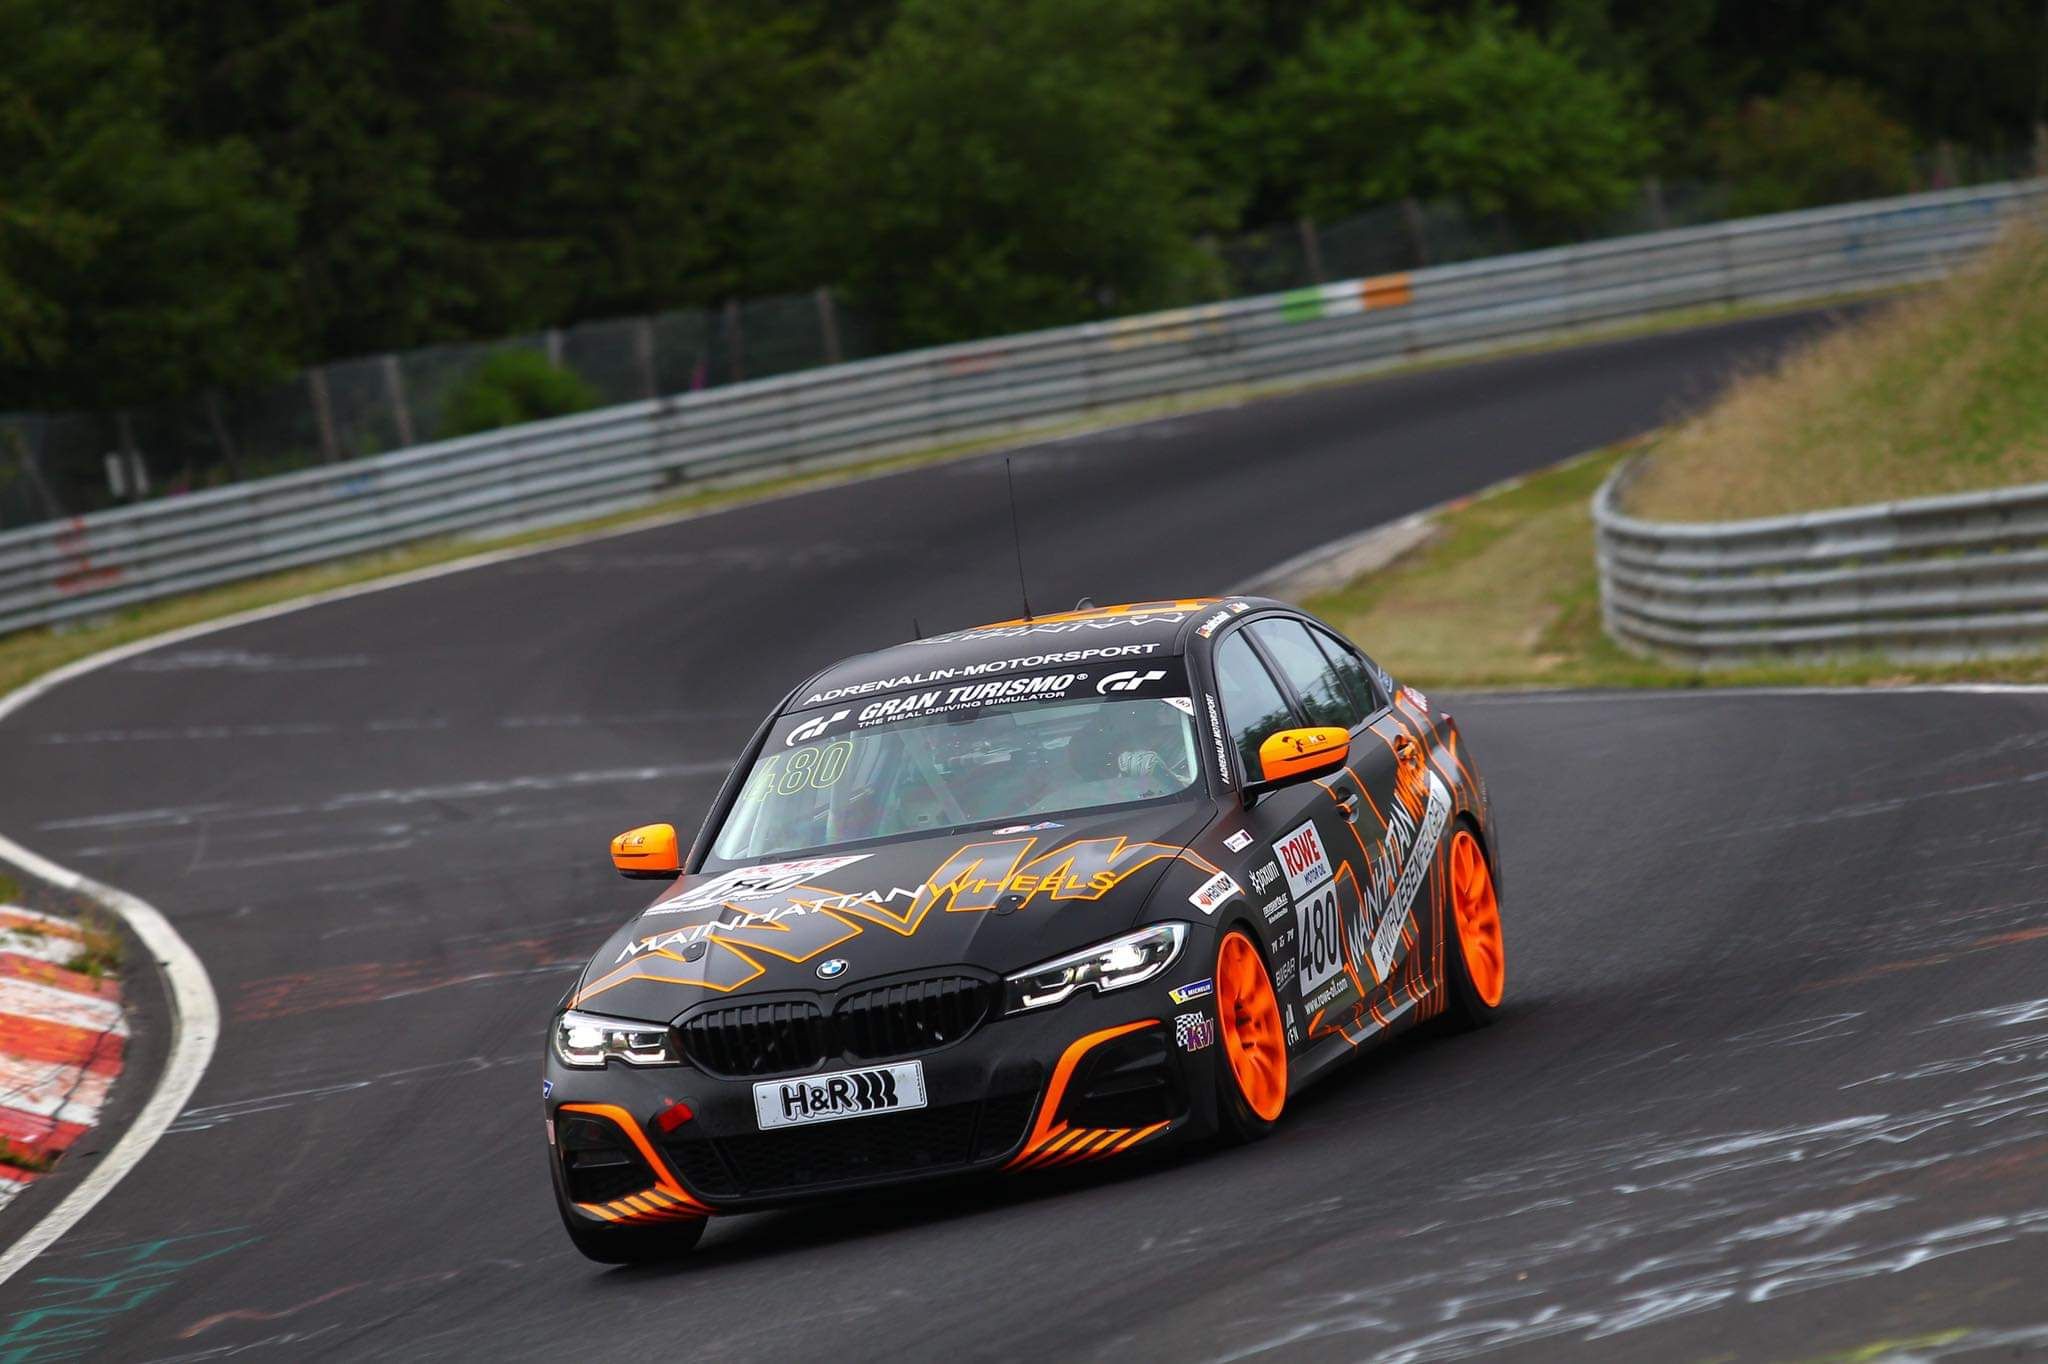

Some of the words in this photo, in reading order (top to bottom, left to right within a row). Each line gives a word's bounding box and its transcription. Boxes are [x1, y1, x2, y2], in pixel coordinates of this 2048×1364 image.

[803, 643, 1161, 705] ADRENALIN-MOTORSPORT
[857, 718, 884, 729] THE
[887, 711, 922, 723] REAL
[926, 701, 982, 716] DRIVING
[985, 690, 1065, 707] SIMULATOR
[858, 691, 942, 722] GRAN
[1280, 828, 1321, 878] ROWE
[614, 880, 928, 964] MAINHATTAN
[927, 868, 1118, 899] WHEELS
[1300, 890, 1338, 981] 480
[1187, 984, 1211, 996] MICHELIN
[1186, 1018, 1214, 1052] KW
[780, 1078, 857, 1120] H&R
